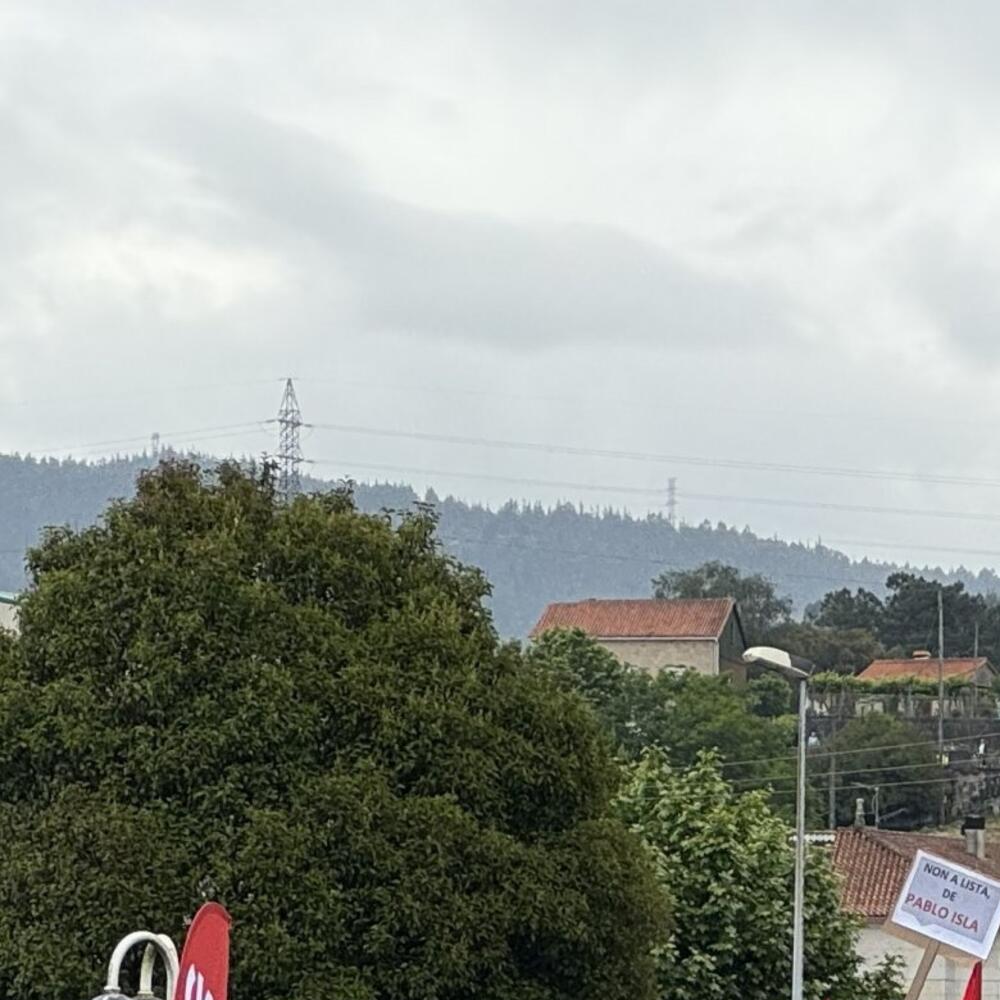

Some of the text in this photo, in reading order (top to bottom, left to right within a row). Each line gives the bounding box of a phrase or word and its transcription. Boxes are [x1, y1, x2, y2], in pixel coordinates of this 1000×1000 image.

[923, 863, 950, 881] NON
[950, 874, 959, 886] A
[942, 888, 958, 902] DE
[905, 893, 979, 934] PABLO ISLA
